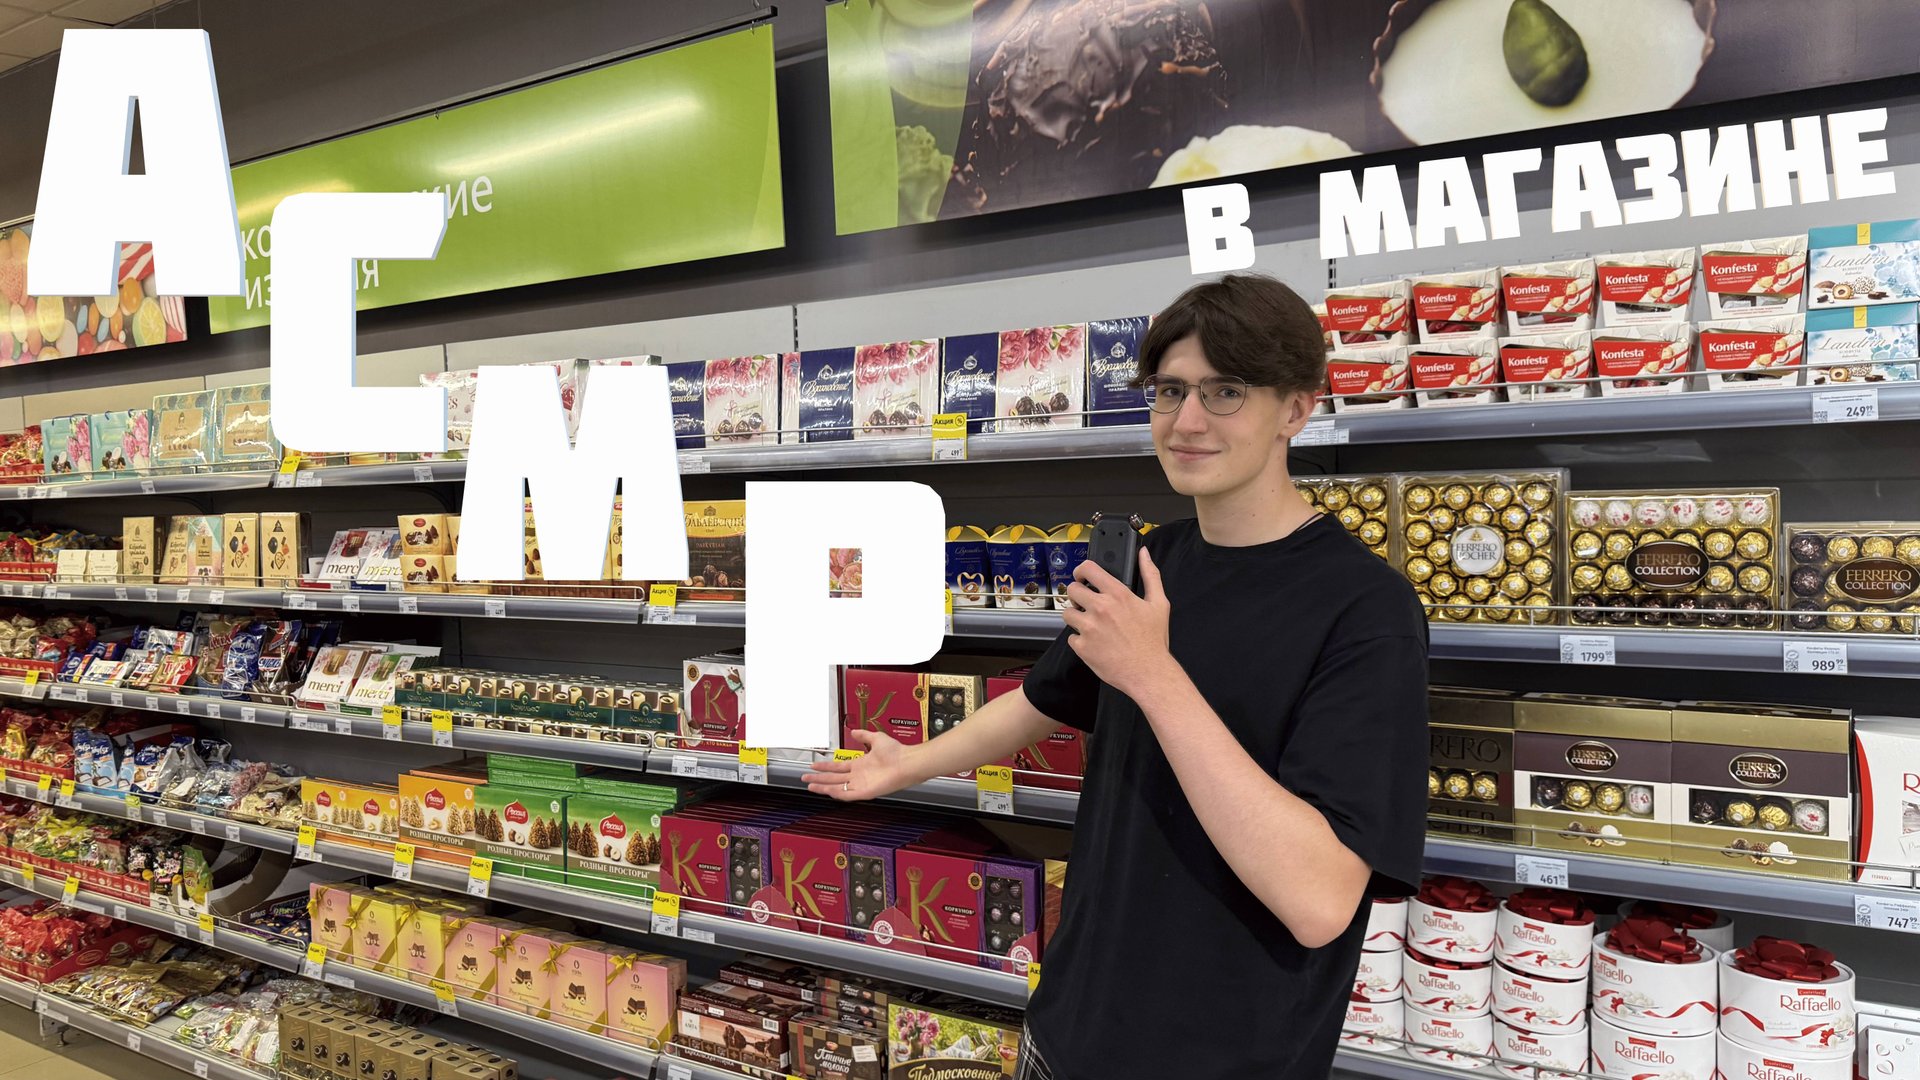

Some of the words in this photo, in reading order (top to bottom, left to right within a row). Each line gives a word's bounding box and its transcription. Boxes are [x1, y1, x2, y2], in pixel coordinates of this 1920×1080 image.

[1821, 252, 1890, 269] Landrin
[1710, 262, 1758, 275] Konfesta
[1605, 273, 1649, 286] Konfesta
[1509, 284, 1550, 296] Konfesta
[1419, 293, 1457, 305] Konfesta
[1332, 305, 1368, 316] Konfesta
[1709, 340, 1756, 353] Konfesta
[1601, 348, 1645, 360] Konfesta
[1508, 355, 1549, 367] Konfesta
[1416, 362, 1455, 373] Konfesta
[1333, 369, 1370, 380] Konfesta
[1846, 407, 1866, 418] 249
[934, 417, 953, 425] Акция
[1456, 543, 1497, 552] FERRERO
[1636, 553, 1700, 567] FERRERO
[326, 564, 359, 574] merc
[365, 565, 402, 576] merc
[1635, 565, 1700, 576] COLLECTION
[1845, 569, 1912, 582] FERRERO
[1845, 580, 1911, 590] COLLECTION
[1581, 652, 1605, 662] 1799
[1812, 660, 1835, 671] 989
[308, 680, 344, 693] merci
[355, 686, 393, 699] merci
[891, 718, 919, 726] КОРКУНОВ
[1571, 757, 1611, 767] COLLECTION
[1736, 761, 1781, 773] FERRERO
[978, 768, 998, 777] Акция
[1736, 770, 1780, 780] COLLECTION
[506, 807, 526, 818] Россия
[602, 821, 623, 832] Россия
[409, 830, 432, 839] РОДНЫЕ
[433, 836, 463, 845] ПРОСТОРЫ
[487, 844, 513, 855] РОДНЫЕ
[514, 848, 550, 861] ПРОСТОРЫ
[580, 860, 607, 873] РОДНЫЕ
[609, 864, 648, 878] ПРОСТОРЫ
[1540, 874, 1558, 885] 461
[814, 883, 842, 893] КОРКУНОВ
[944, 906, 975, 915] КОРКУНОВ
[1423, 915, 1464, 932] Raffaello
[1888, 916, 1909, 928] 747
[1513, 925, 1556, 946] Raffaello
[1419, 973, 1461, 991] Raffaello
[1503, 983, 1544, 1003] Raffaello
[1780, 995, 1841, 1012] Raffaello
[1422, 1022, 1464, 1039] Raffaello
[1508, 1038, 1552, 1057] Raffaello
[1615, 1041, 1674, 1064] Raffaello
[814, 1048, 852, 1066] Птичье
[820, 1062, 849, 1074] молоко
[908, 1064, 1002, 1080] Подмосковные
